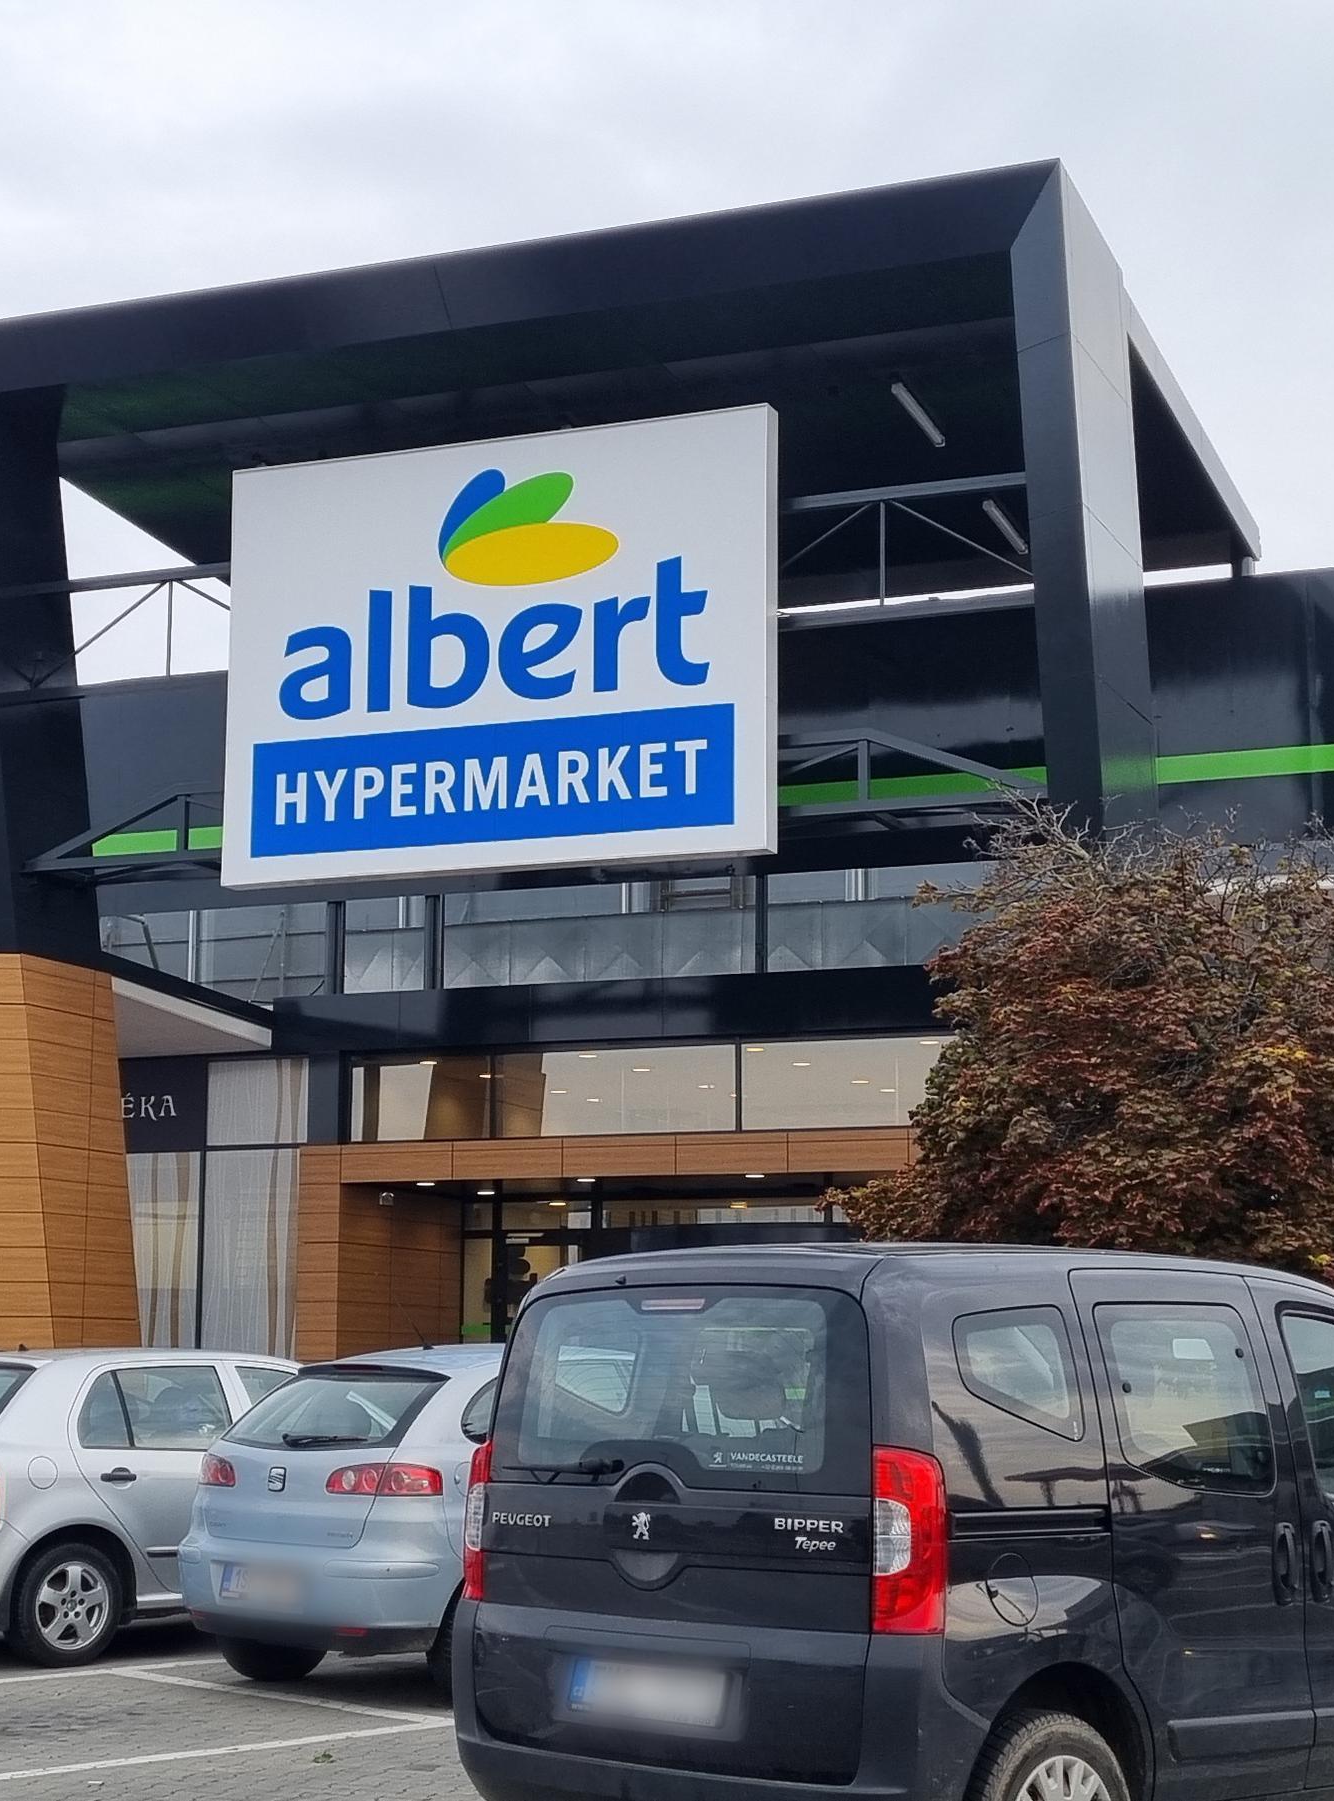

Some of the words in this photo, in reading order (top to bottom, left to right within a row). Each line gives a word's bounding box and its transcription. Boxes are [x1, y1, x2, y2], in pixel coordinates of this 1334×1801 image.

[279, 555, 711, 721] albert
[274, 738, 709, 826] HYPERMARKET
[491, 1511, 552, 1528] PEUGEOT
[773, 1517, 844, 1534] BIPPER
[794, 1536, 837, 1553] Tepee
